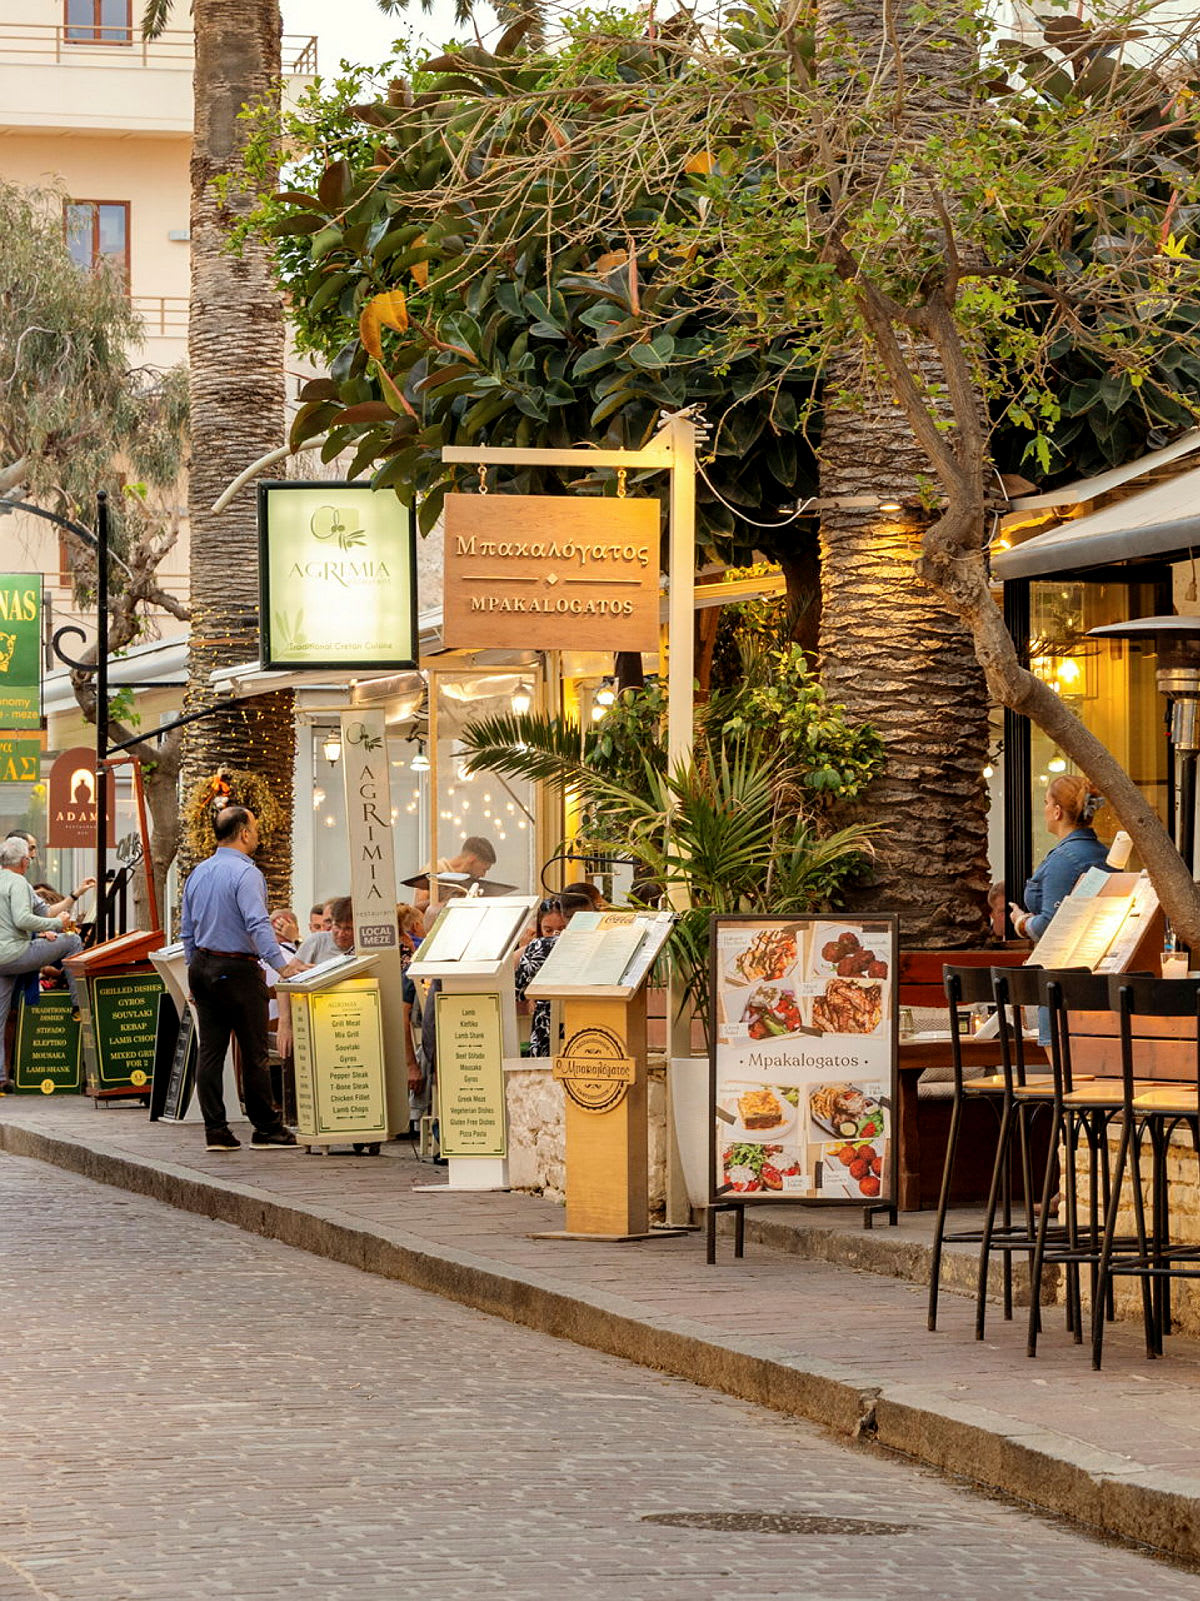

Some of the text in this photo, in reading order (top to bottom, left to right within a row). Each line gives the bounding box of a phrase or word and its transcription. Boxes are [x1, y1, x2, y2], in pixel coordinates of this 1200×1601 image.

[456, 536, 649, 566] Μπακαλόγατος
[289, 561, 391, 588] AGRIMIA
[471, 597, 634, 615] MPAKALOGATOS
[0, 756, 37, 781] ΑΣ
[56, 811, 110, 821] ADAM
[359, 765, 391, 899] AGRIMIA
[361, 926, 391, 937] LOCAL
[363, 936, 391, 945] MEZE
[100, 986, 133, 995] GRILLED
[118, 998, 146, 1006] GYROS
[112, 1009, 153, 1019] SOUVLAKI
[120, 1023, 148, 1031] KEBAP
[109, 1034, 157, 1045] LAMB CHOP
[110, 1051, 137, 1060] MIXED
[339, 1055, 357, 1063] Gyros
[126, 1060, 142, 1068] FOR
[748, 1052, 859, 1070] Mpakalogatos
[330, 1072, 351, 1080] Pepper
[331, 1095, 353, 1103] Chicken
[333, 1106, 350, 1114] Lamb
